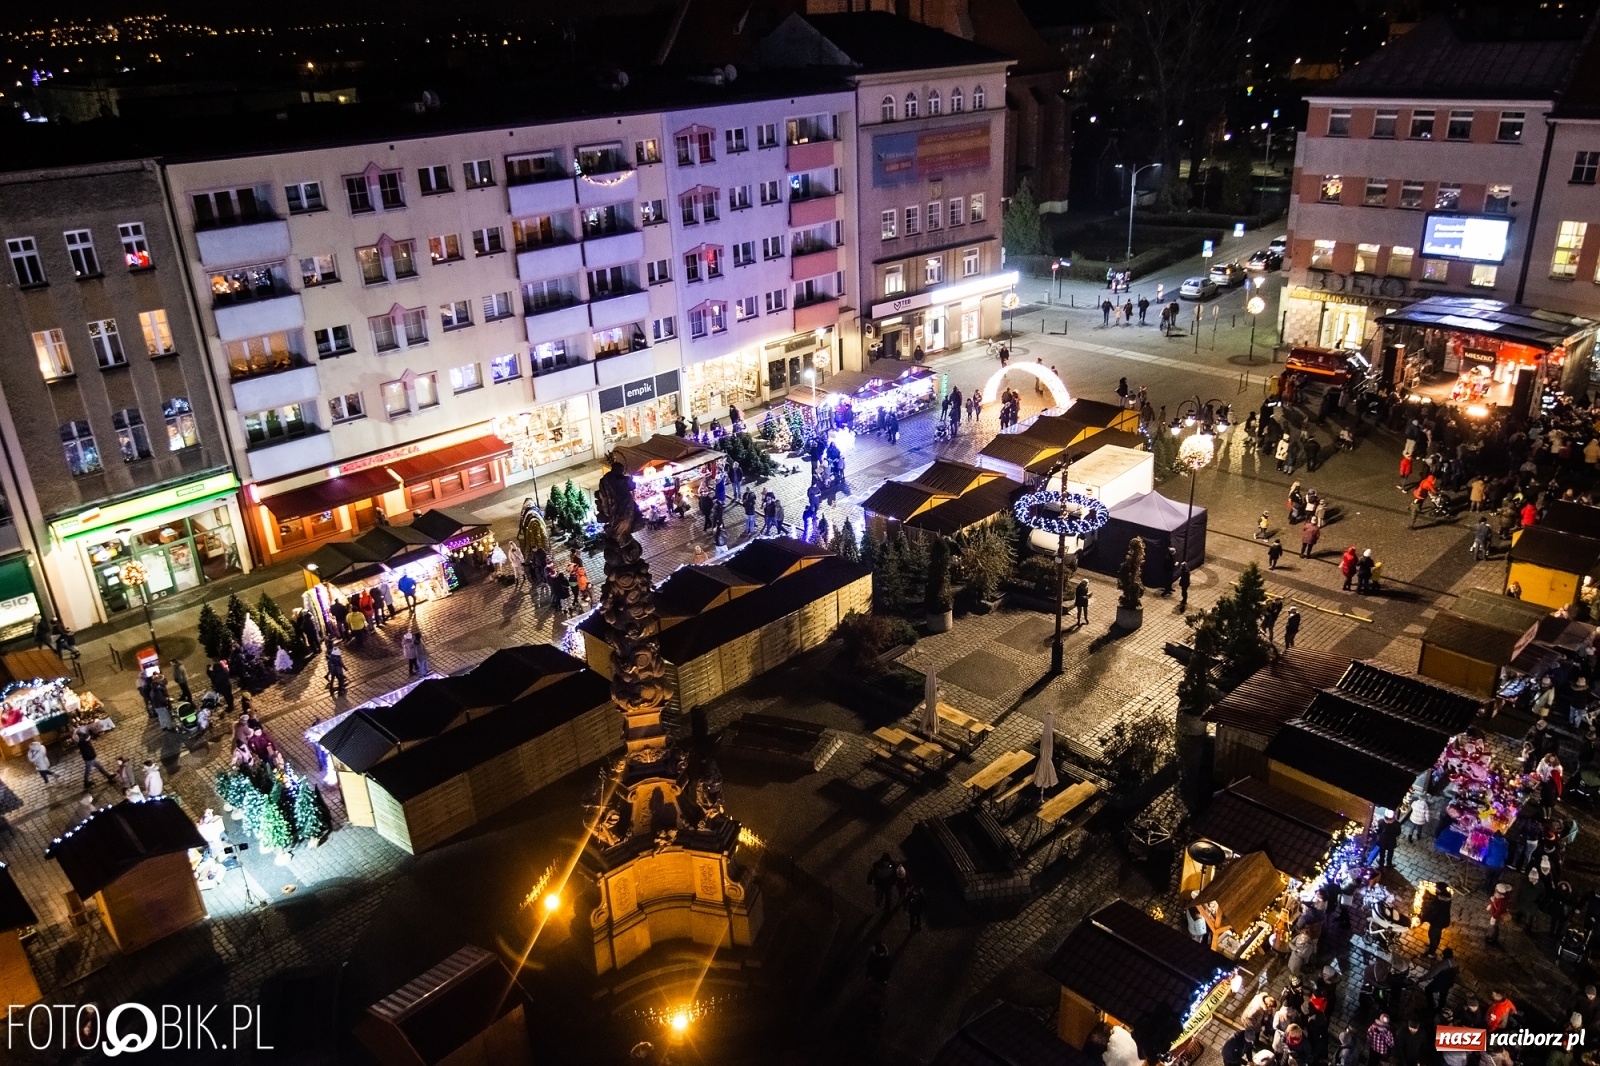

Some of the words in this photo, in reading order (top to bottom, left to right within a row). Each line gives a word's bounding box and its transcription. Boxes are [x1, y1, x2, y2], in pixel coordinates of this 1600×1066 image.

[1314, 293, 1374, 306] DELIKATESY
[1464, 351, 1494, 362] MIESZKO
[627, 382, 652, 398] empik
